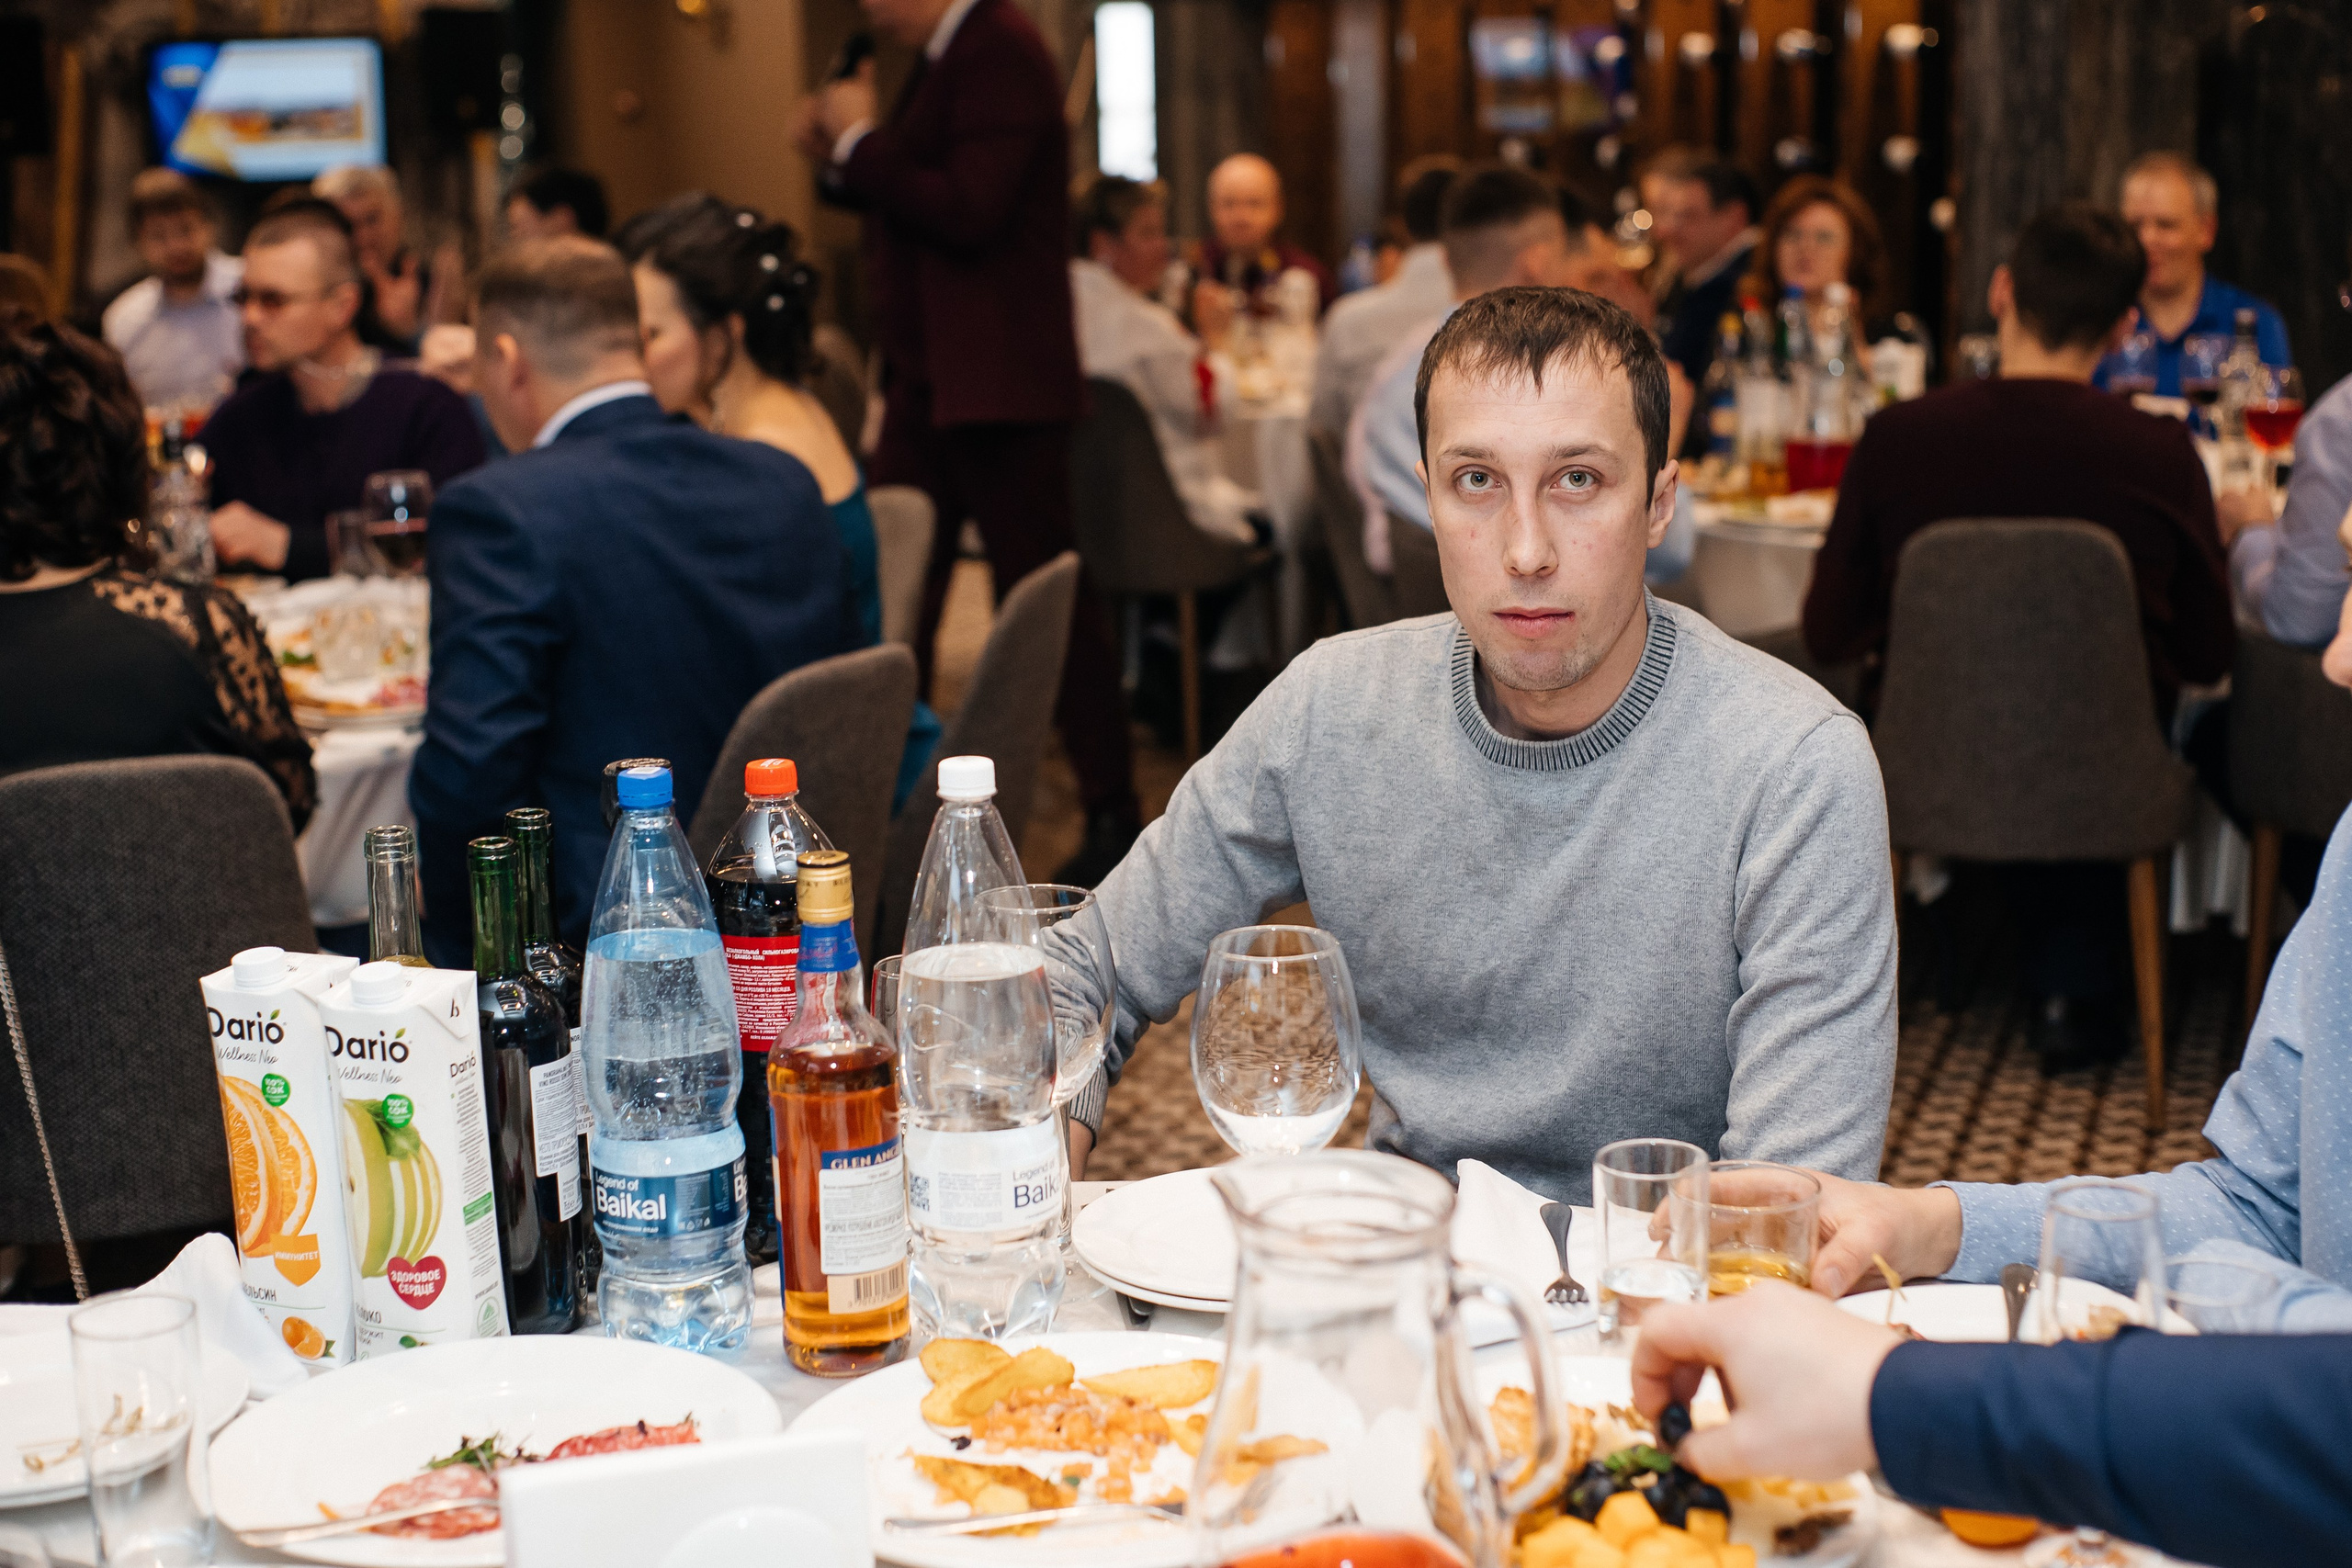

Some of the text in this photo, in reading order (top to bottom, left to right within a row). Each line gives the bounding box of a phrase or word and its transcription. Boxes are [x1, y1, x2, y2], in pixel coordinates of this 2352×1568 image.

[830, 1154, 872, 1170] GLEN
[1012, 1162, 1048, 1181] Legend
[595, 1170, 639, 1191] Legend of
[596, 1184, 667, 1221] Baikal
[275, 1250, 319, 1262] ИММУНИТЕТ
[390, 1268, 442, 1284] ЗДОРОВОЕ
[397, 1281, 435, 1298] СЕРДЦЕ
